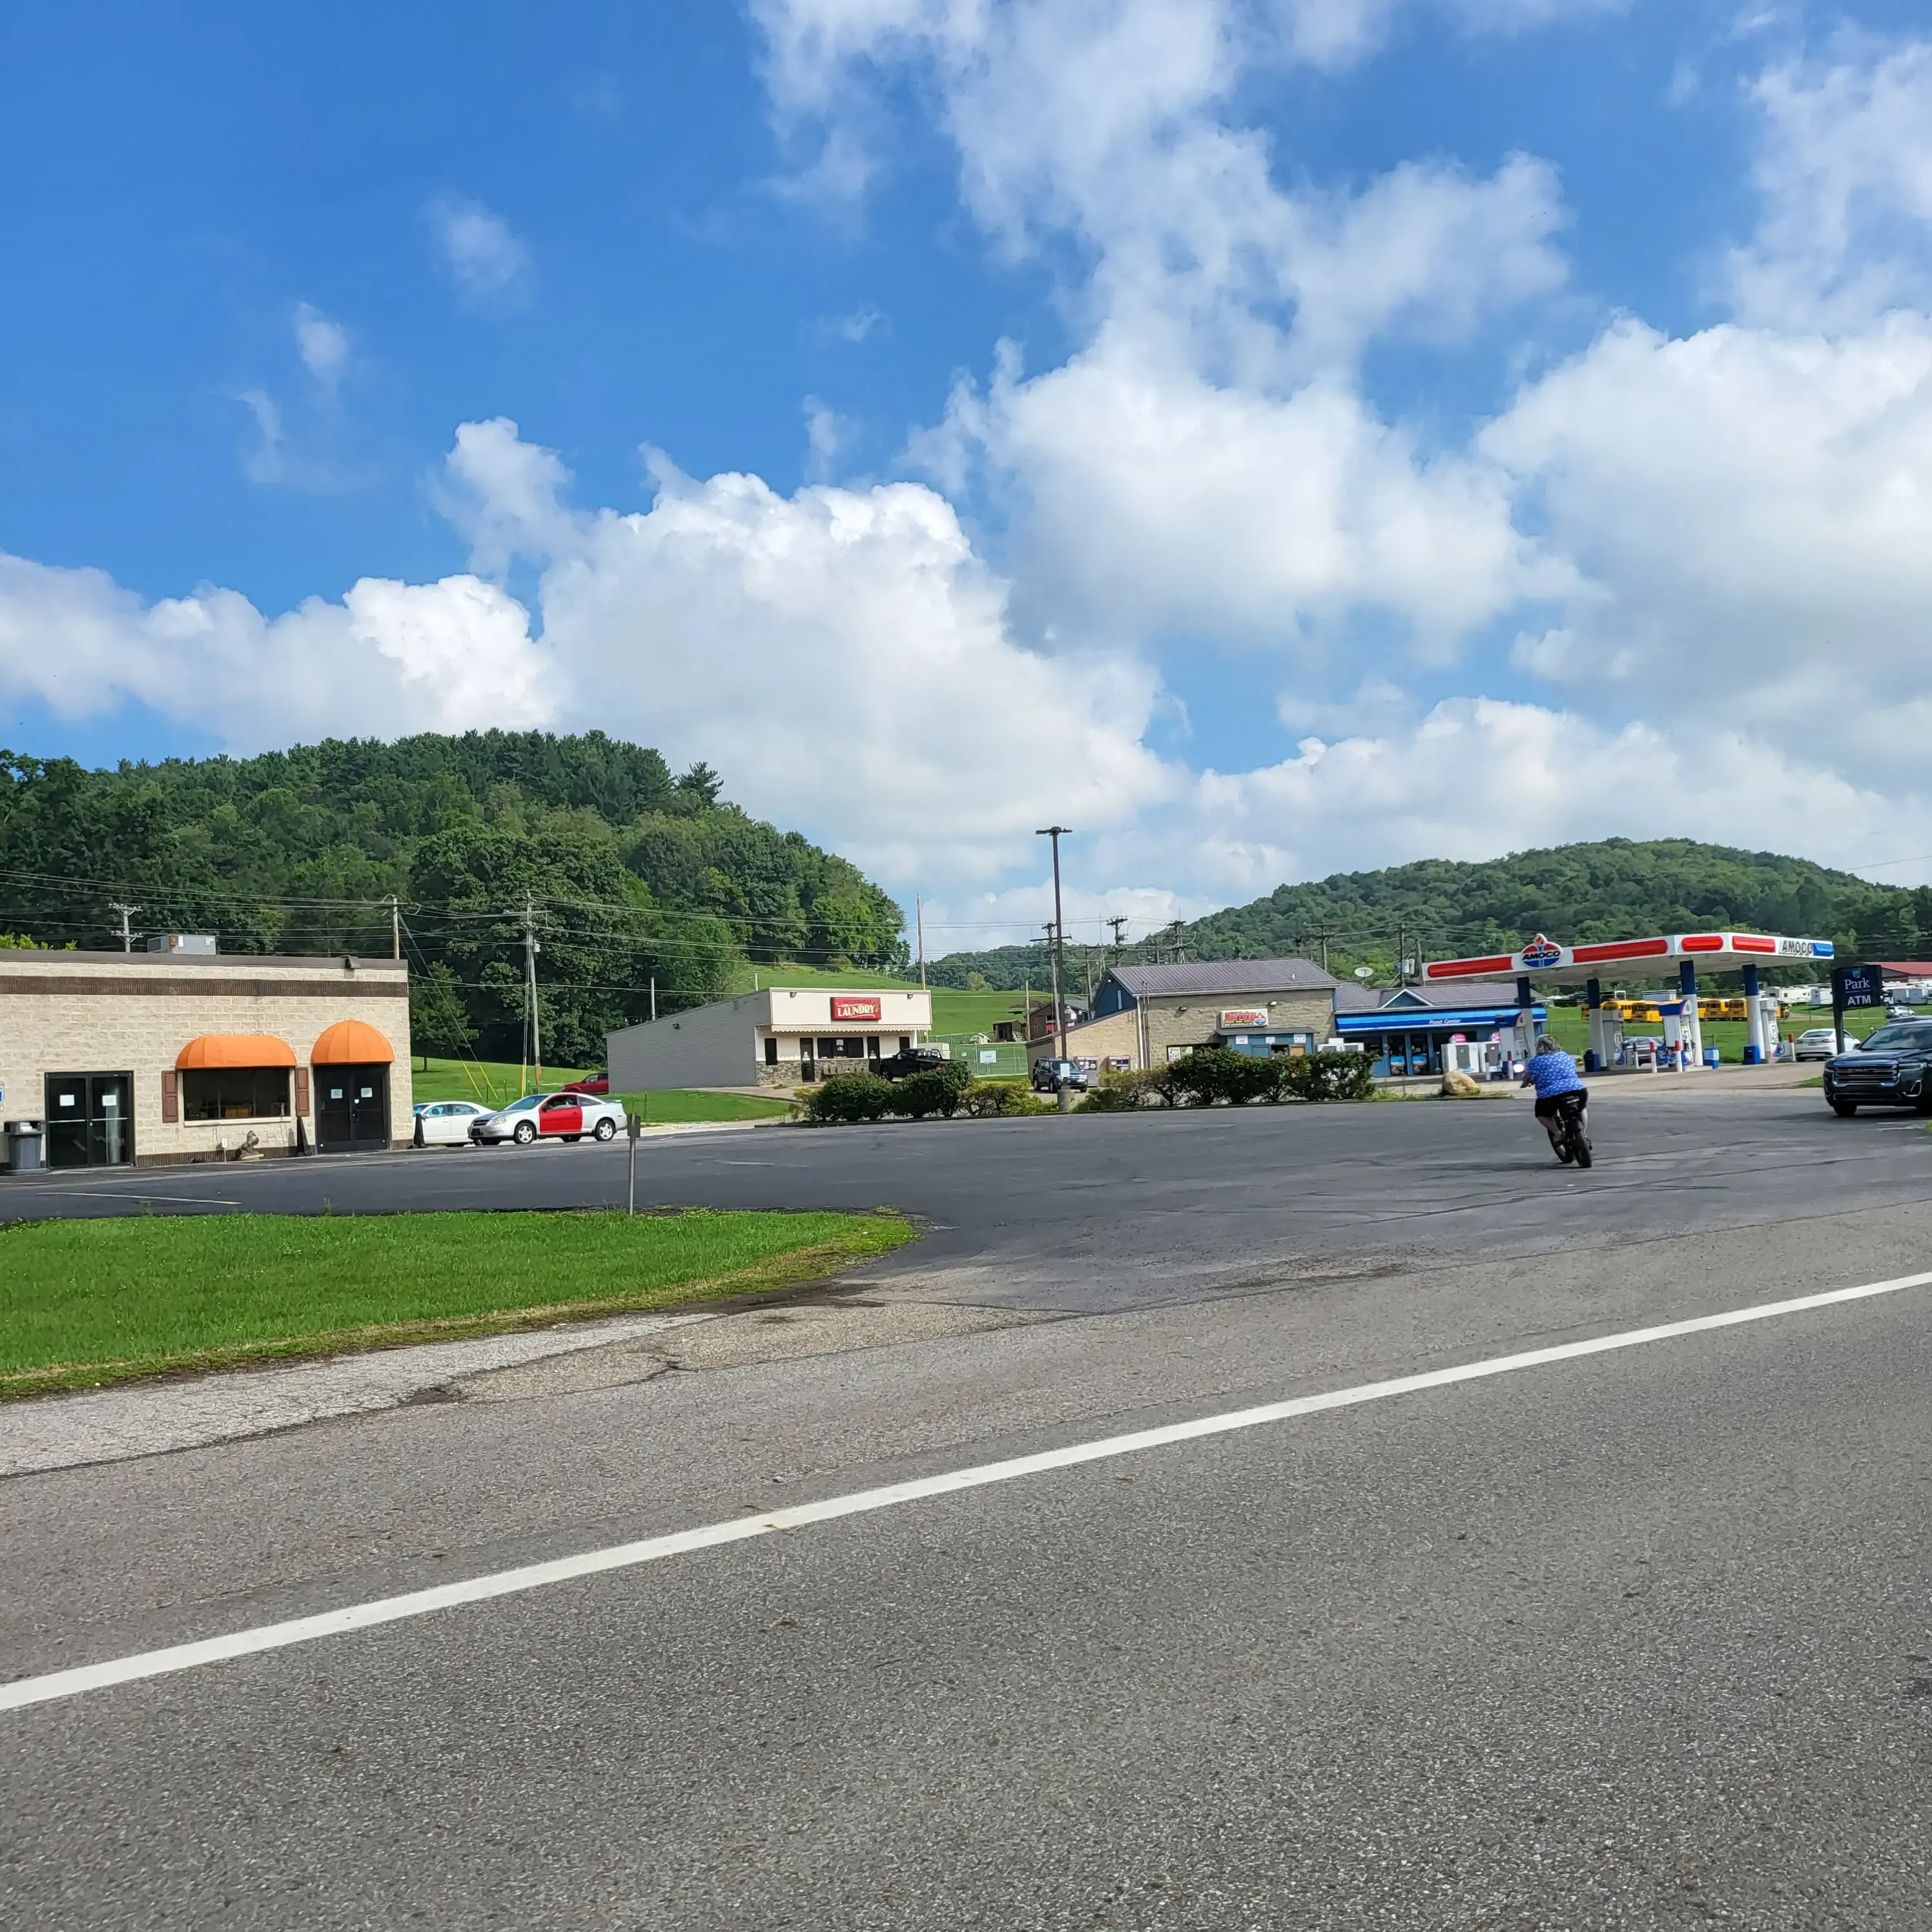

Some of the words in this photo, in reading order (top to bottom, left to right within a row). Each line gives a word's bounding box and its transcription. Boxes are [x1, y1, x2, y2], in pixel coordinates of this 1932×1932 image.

[1781, 940, 1813, 954] AMOCO
[1521, 950, 1561, 960] AMOCO
[1844, 977, 1871, 990] Park
[1847, 994, 1871, 1005] ATM
[838, 1005, 875, 1017] LAUNDRY
